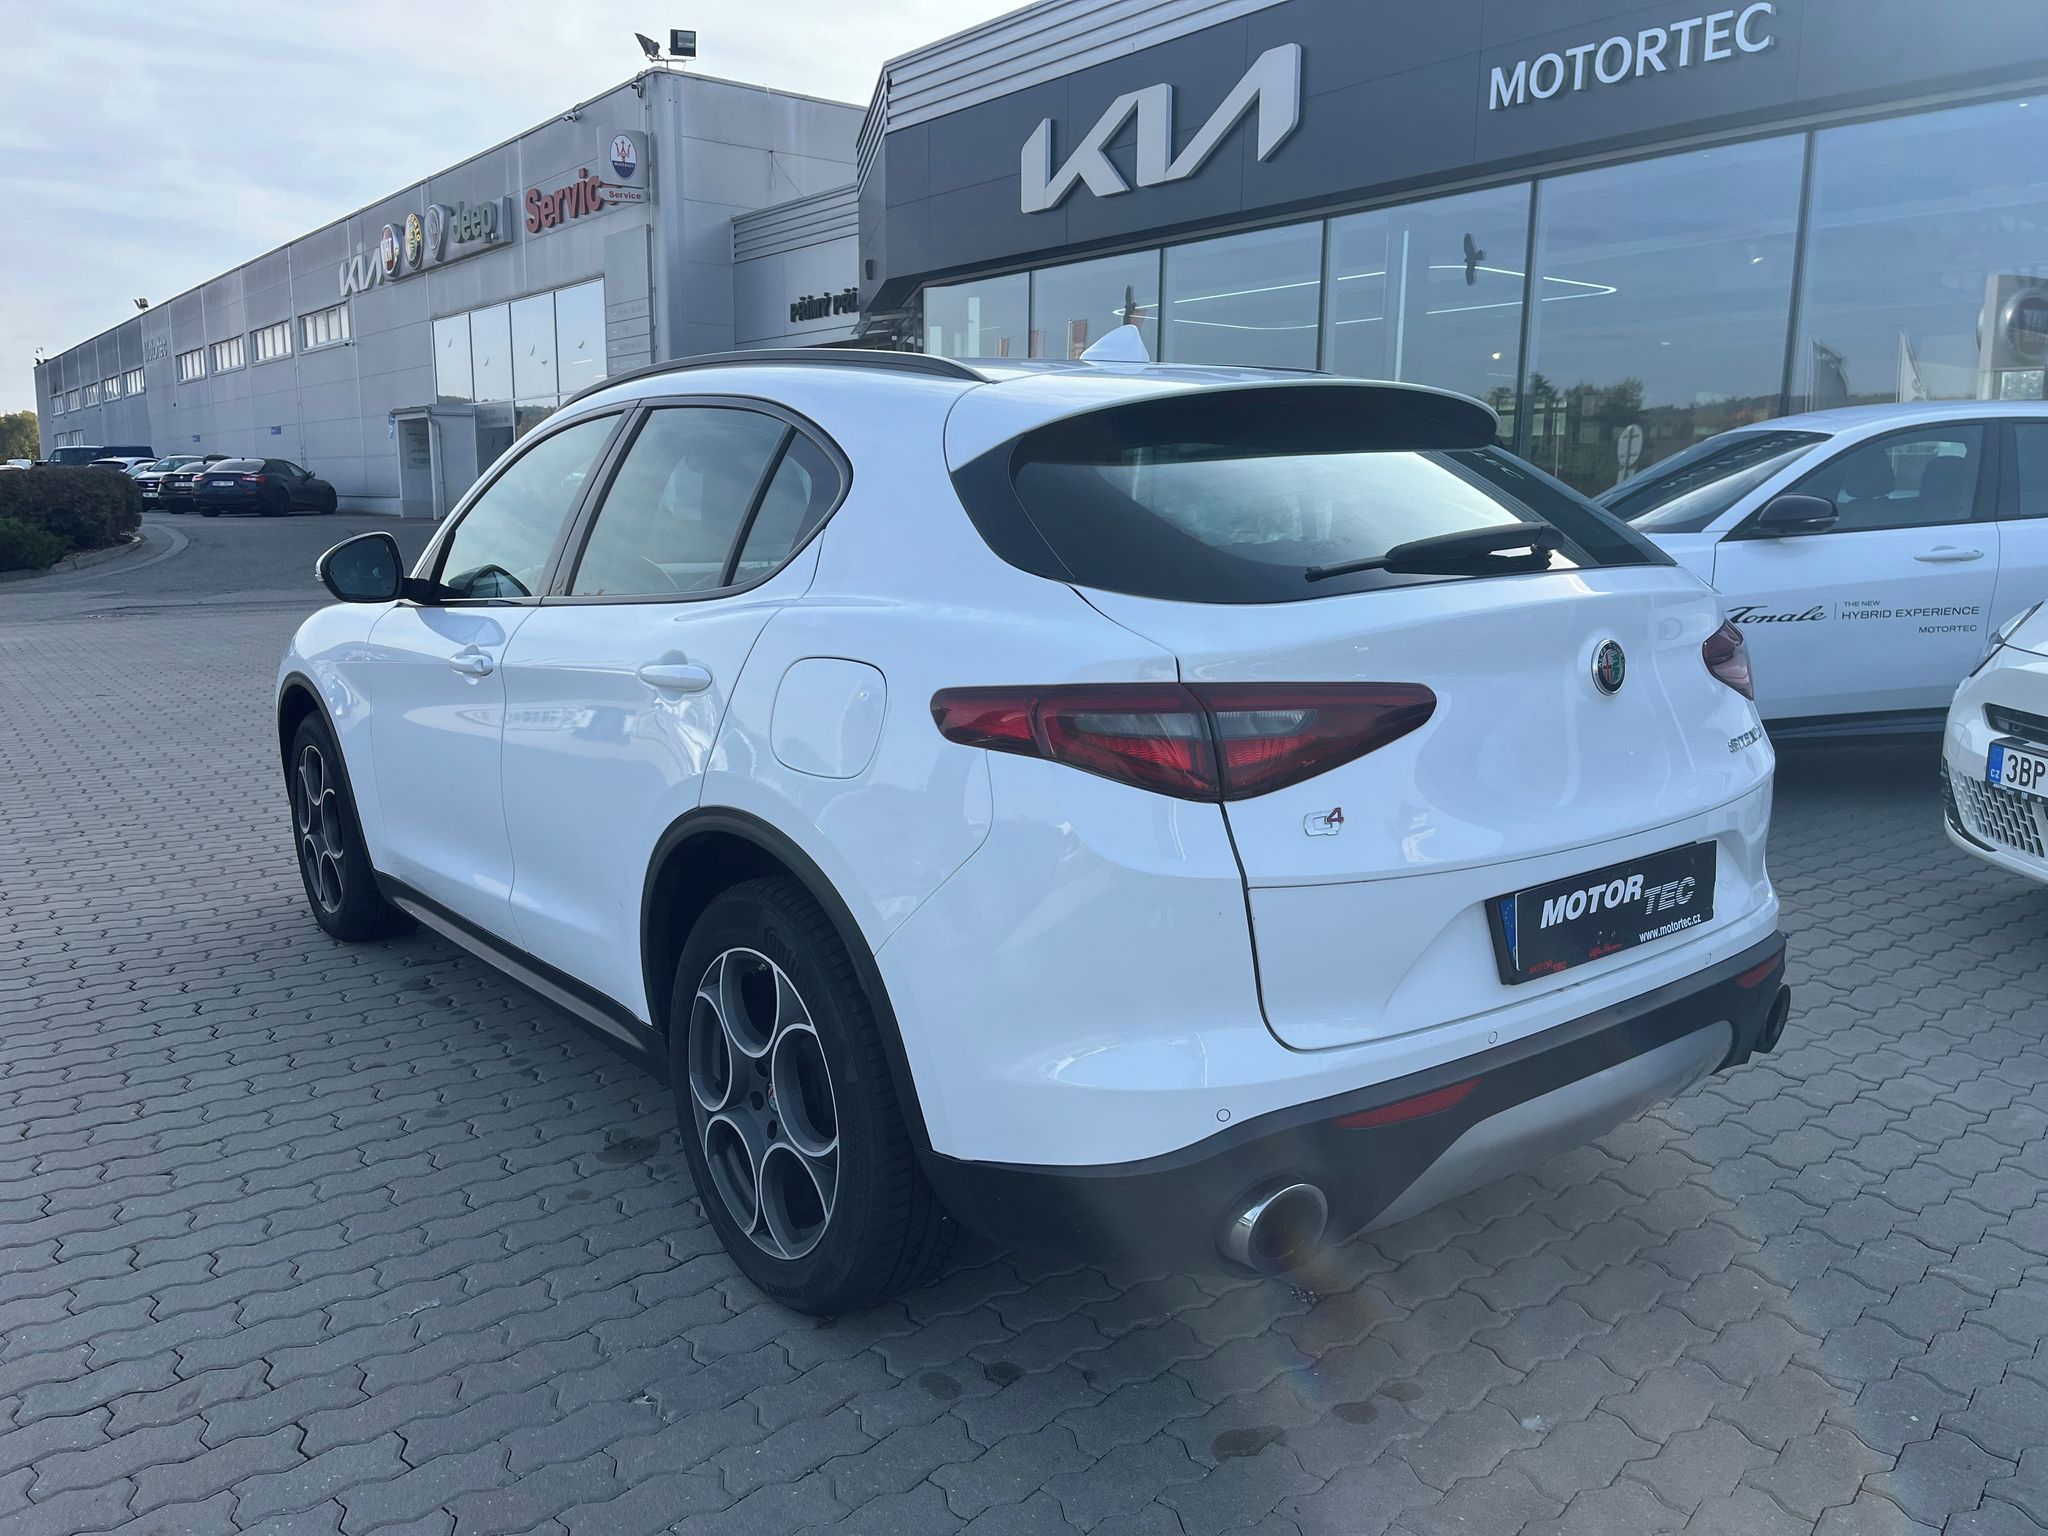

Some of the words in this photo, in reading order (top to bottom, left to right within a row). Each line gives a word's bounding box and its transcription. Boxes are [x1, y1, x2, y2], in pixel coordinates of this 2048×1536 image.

[1489, 2, 1775, 110] MOTORTEC
[1021, 43, 1301, 214] KIA
[525, 167, 614, 234] Servic
[608, 190, 642, 200] Service
[451, 201, 497, 243] Jeep
[1726, 605, 1828, 624] Tonale
[1841, 609, 1892, 620] HYBRID
[1895, 606, 1980, 618] EXPERIENCE
[1918, 624, 1978, 634] MOTORTEC
[1990, 768, 2001, 779] CZ
[2006, 754, 2046, 790] 3BP
[1639, 912, 1702, 943] www.motortec.cz
